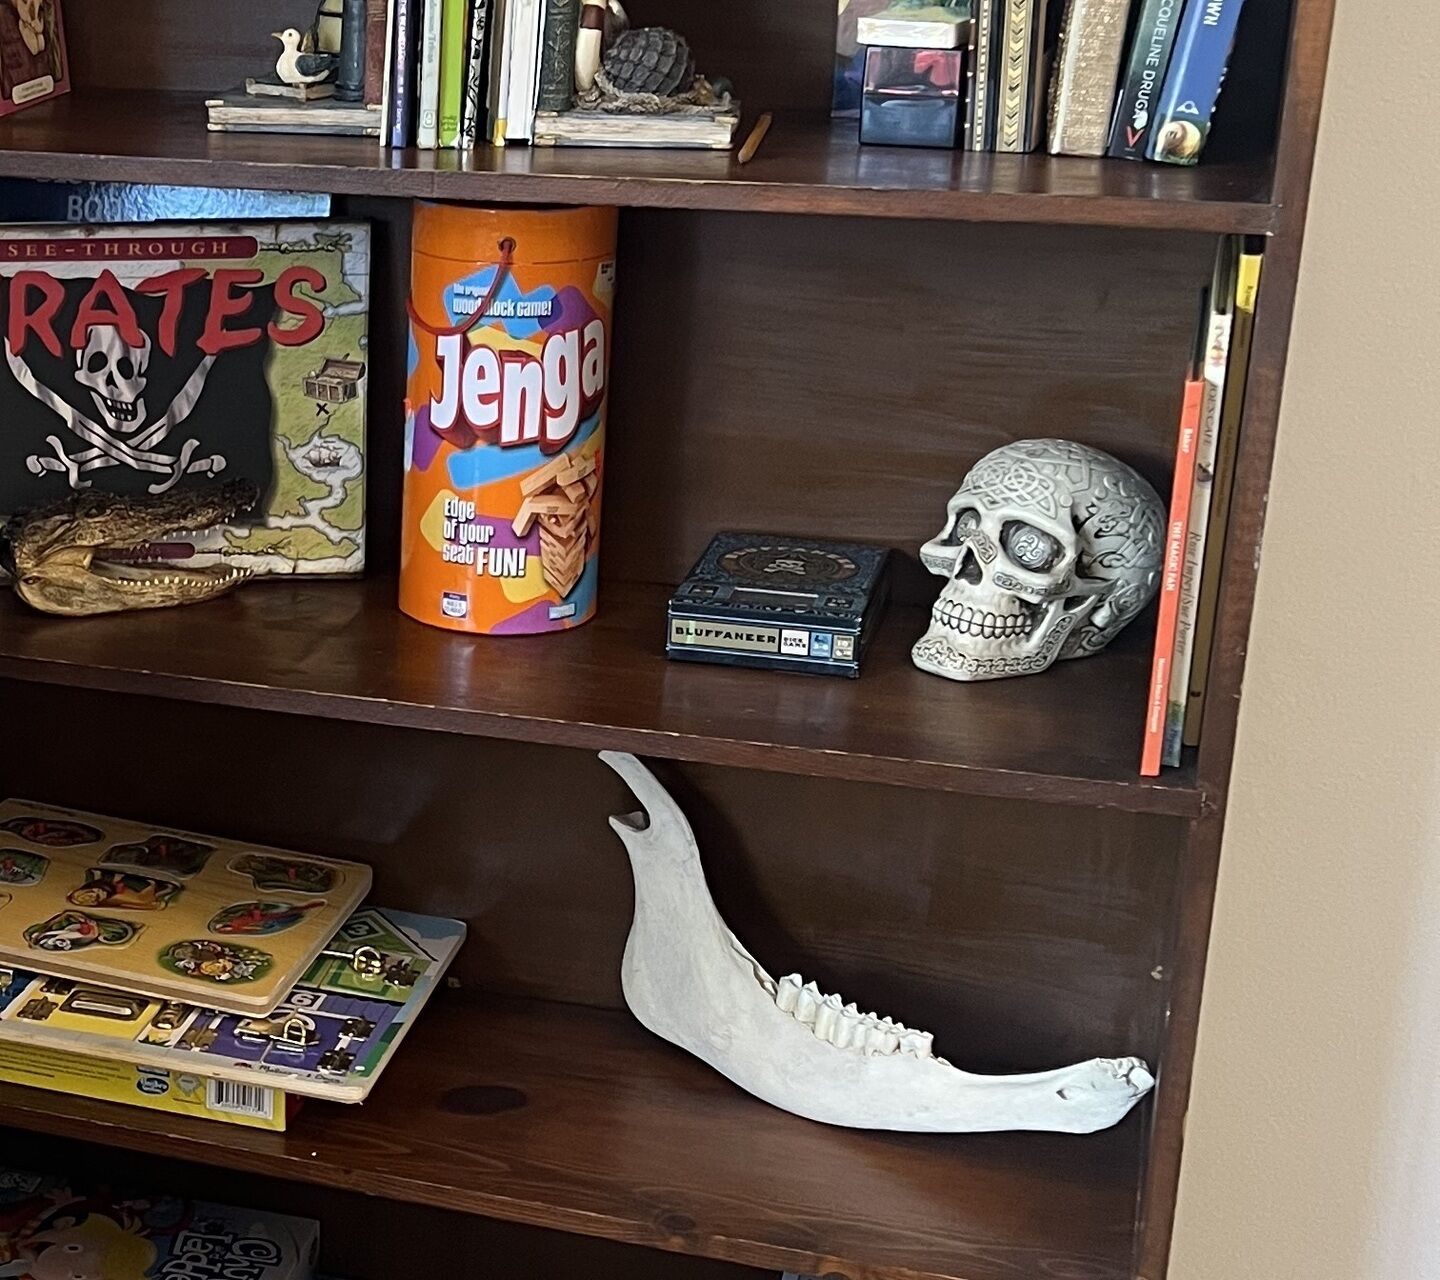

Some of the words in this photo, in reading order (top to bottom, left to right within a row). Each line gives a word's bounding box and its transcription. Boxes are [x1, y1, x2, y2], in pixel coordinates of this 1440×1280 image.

[7, 240, 230, 259] SEE-THROUGH
[430, 319, 605, 444] Jenga
[1181, 427, 1193, 453] Baker
[444, 496, 475, 522] Edge
[443, 519, 458, 539] of
[459, 525, 495, 545] your
[1172, 521, 1182, 539] THE
[442, 544, 474, 564] seat
[476, 547, 526, 577] FUN!
[1166, 572, 1177, 592] FAN
[675, 626, 776, 645] BLUFFANEER
[783, 636, 803, 644] DICE
[1177, 620, 1190, 657] Porter
